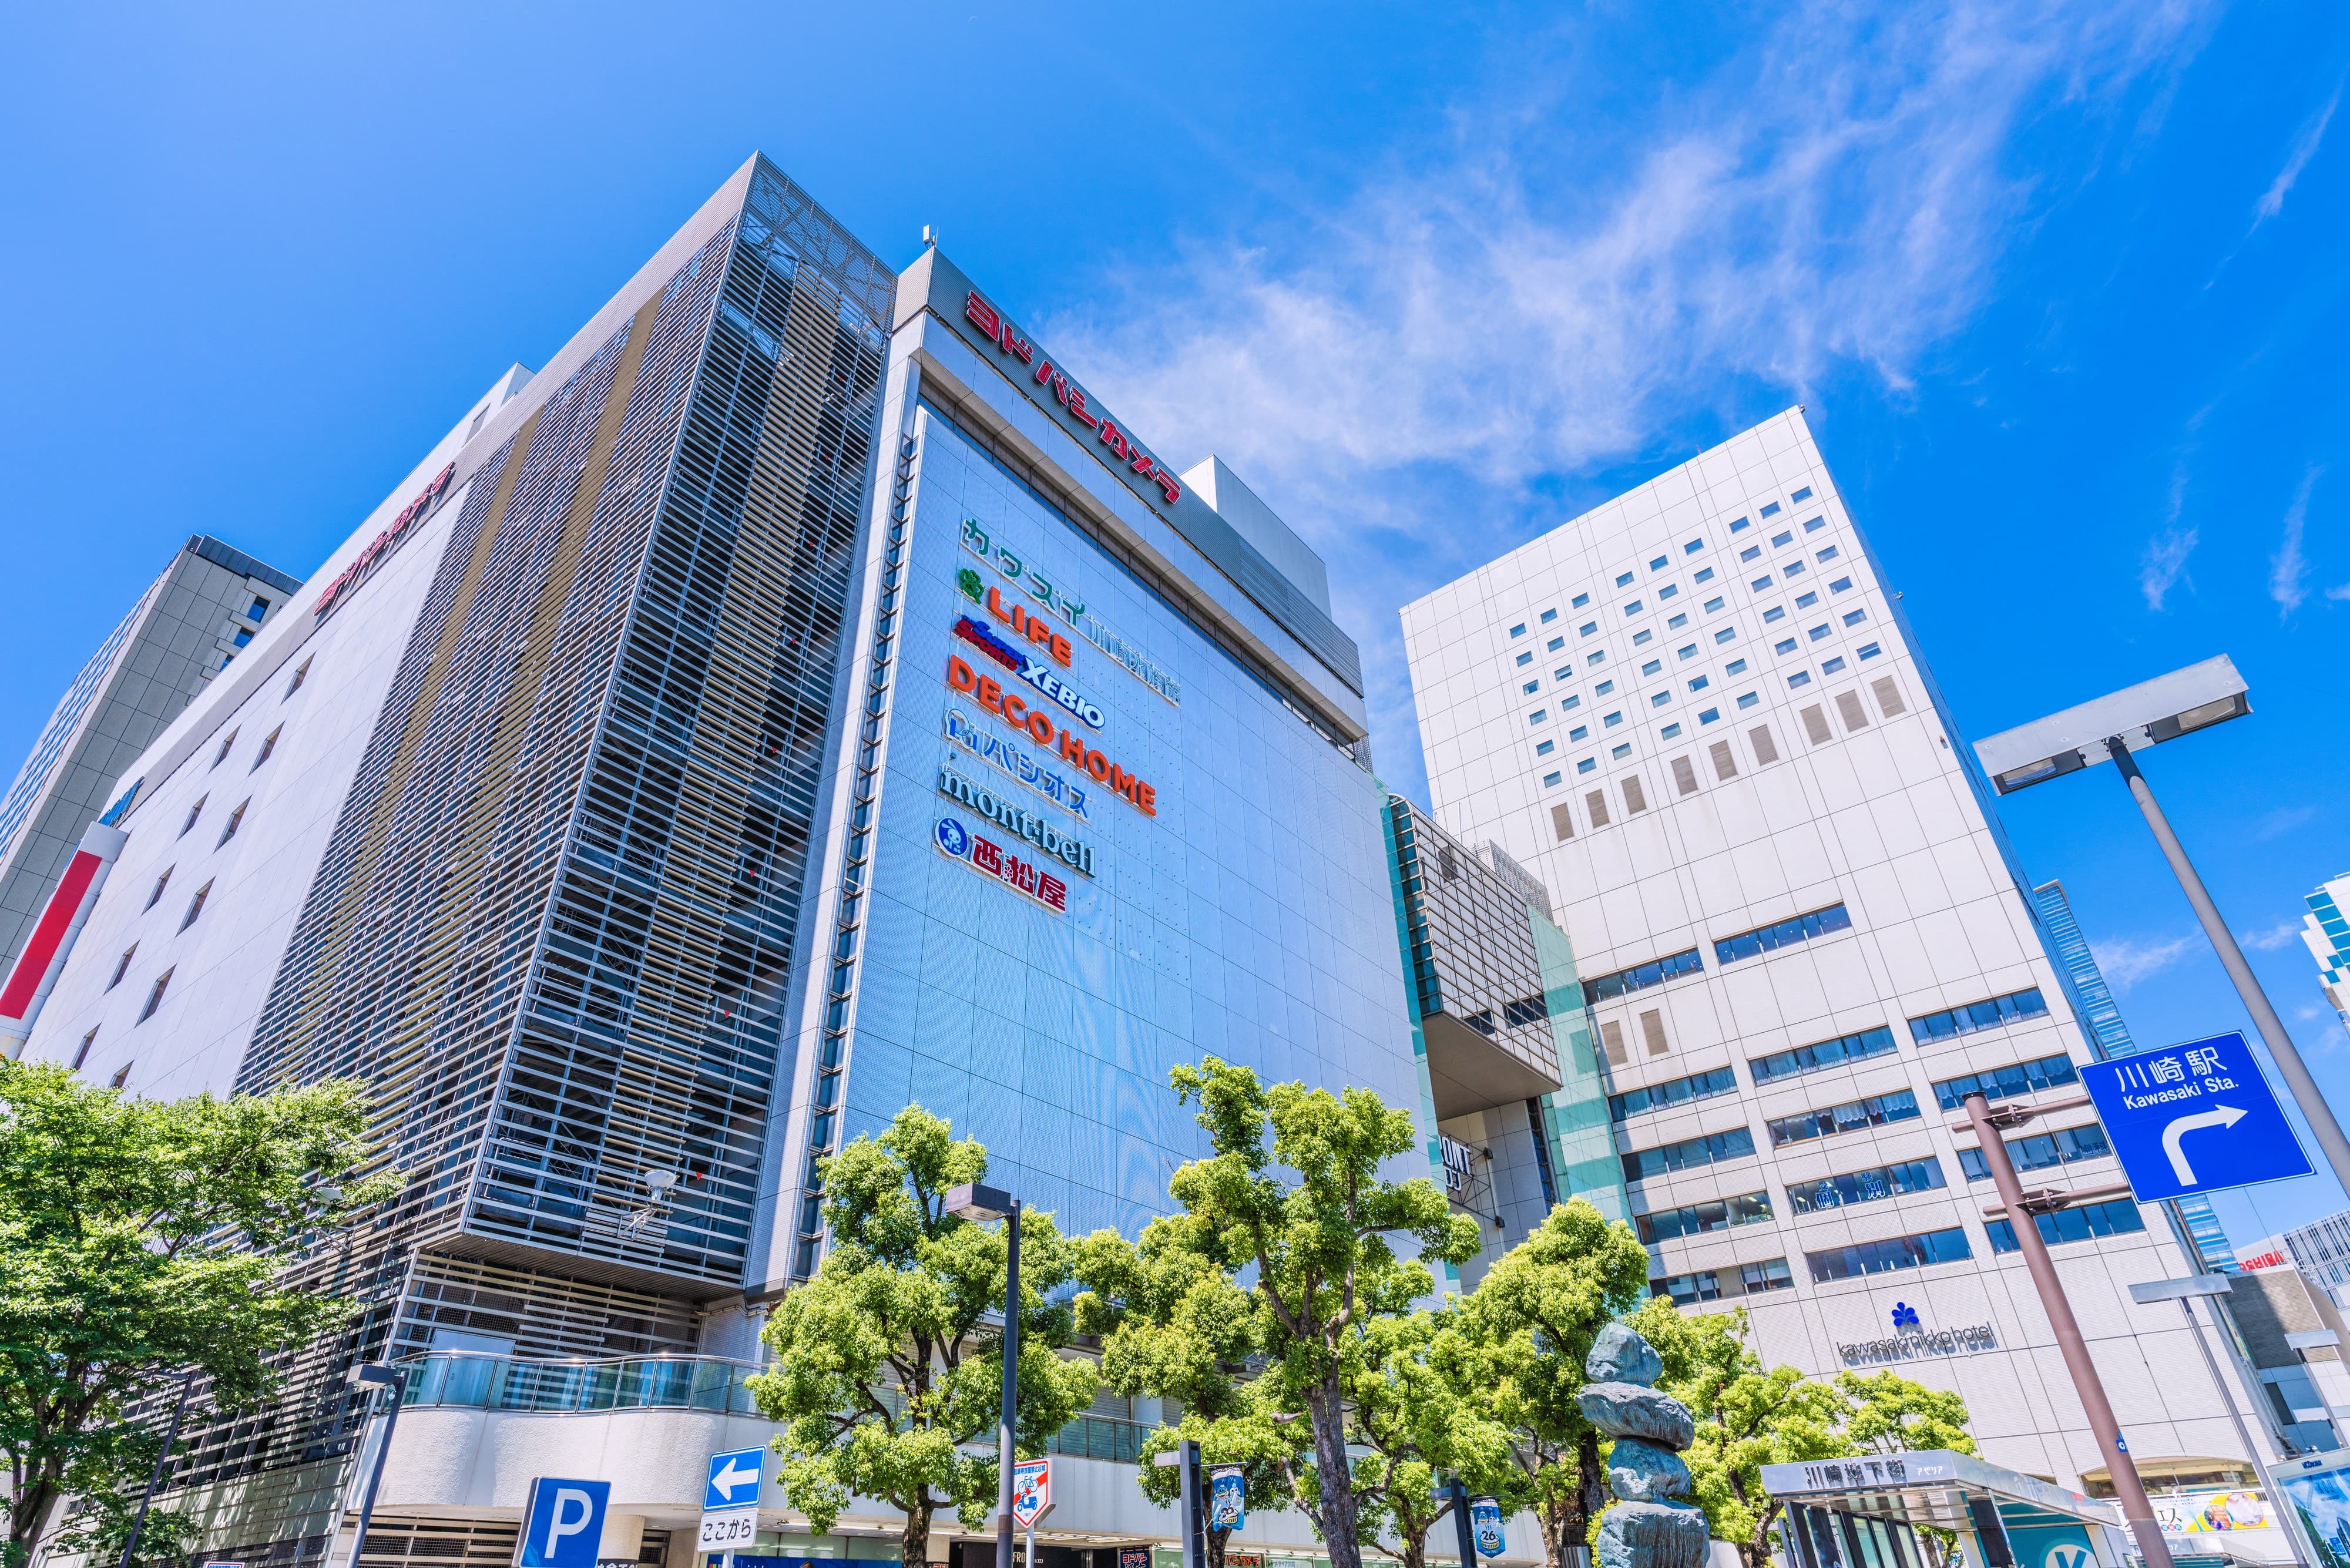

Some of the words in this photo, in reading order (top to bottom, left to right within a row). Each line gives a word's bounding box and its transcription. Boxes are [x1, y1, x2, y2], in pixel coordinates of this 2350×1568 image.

[966, 290, 1181, 504] ヨドバシカメラ
[964, 518, 1086, 626] カワスイ
[989, 586, 1072, 668] LIFE
[954, 620, 1018, 671] SPORTS
[1018, 654, 1105, 729] XEBIO
[948, 654, 1055, 744] DECO
[1061, 729, 1157, 817] HOME
[982, 737, 1089, 819] パシオス
[971, 833, 1067, 913] 西松屋
[2115, 1046, 2227, 1093] 川崎駅
[2123, 1081, 2202, 1110] Kawasaki
[2204, 1076, 2240, 1094] Sta.
[1837, 1333, 1908, 1357] kawasaki
[1909, 1329, 1951, 1348] nikko
[1950, 1321, 1994, 1342] hotel
[1805, 1459, 1906, 1486] 川崎地下街
[1917, 1466, 1943, 1476] アゼリア
[544, 1488, 593, 1559] P
[703, 1519, 751, 1543] ここから
[1123, 1553, 1147, 1563] ヨドバシ
[1481, 1530, 1496, 1540] 26
